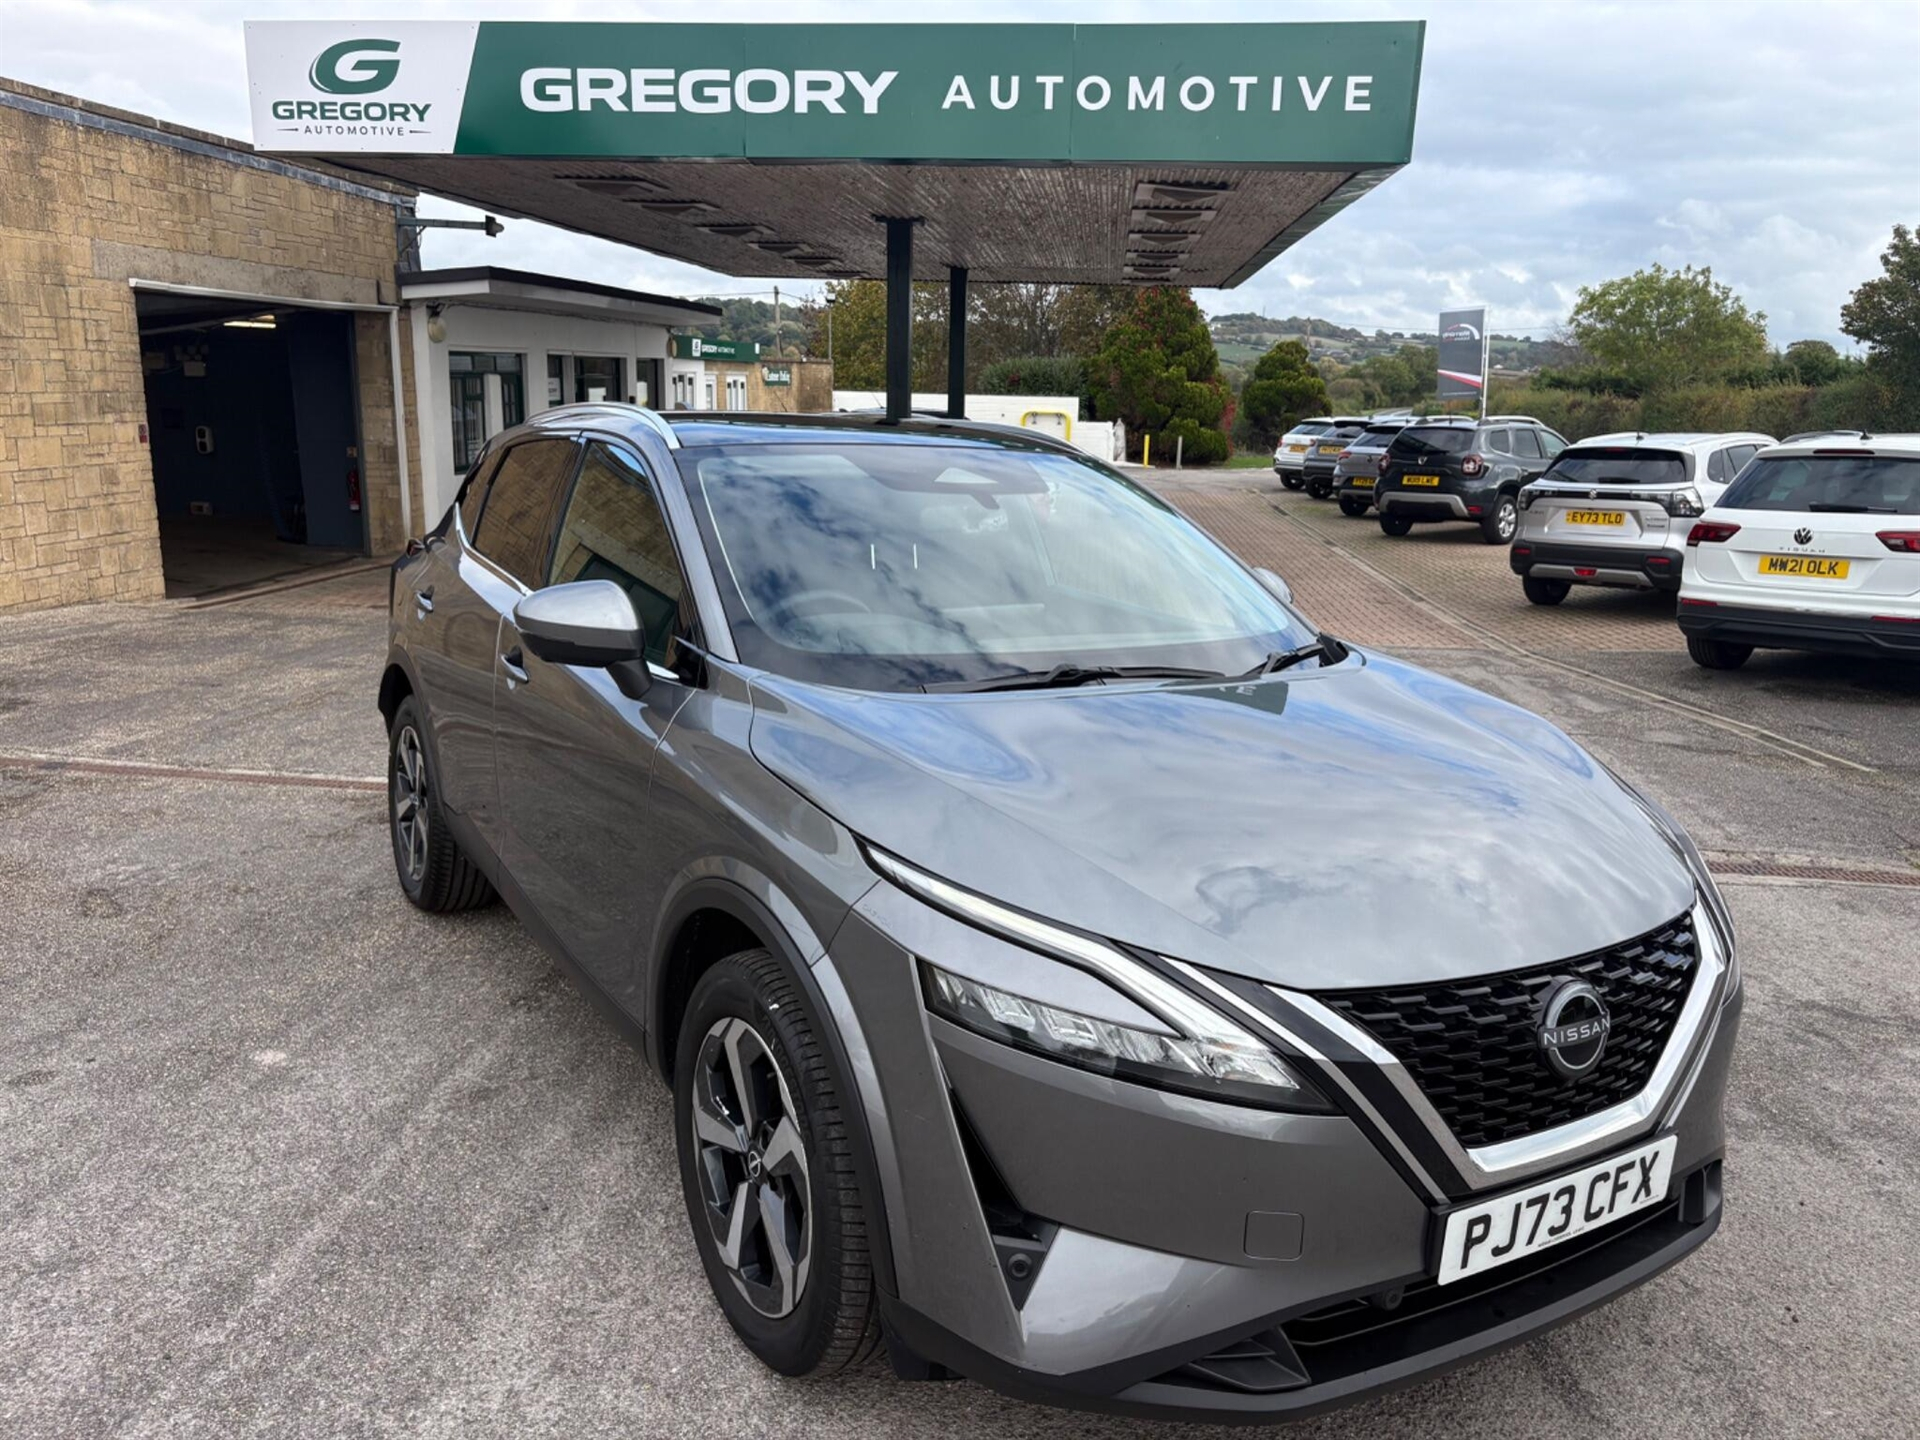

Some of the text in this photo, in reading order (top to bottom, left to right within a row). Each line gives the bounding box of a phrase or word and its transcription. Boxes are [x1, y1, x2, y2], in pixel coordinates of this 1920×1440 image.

[521, 67, 1373, 114] GREGORY AUTOMOTIVE
[272, 100, 432, 122] GREGORY
[304, 125, 404, 137] AUTOMOTIVE
[1572, 511, 1599, 523] EY73
[1768, 558, 1839, 576] MW21 OLK
[1543, 1018, 1610, 1046] NISSAN
[1460, 1151, 1660, 1270] PJ73 CFX
